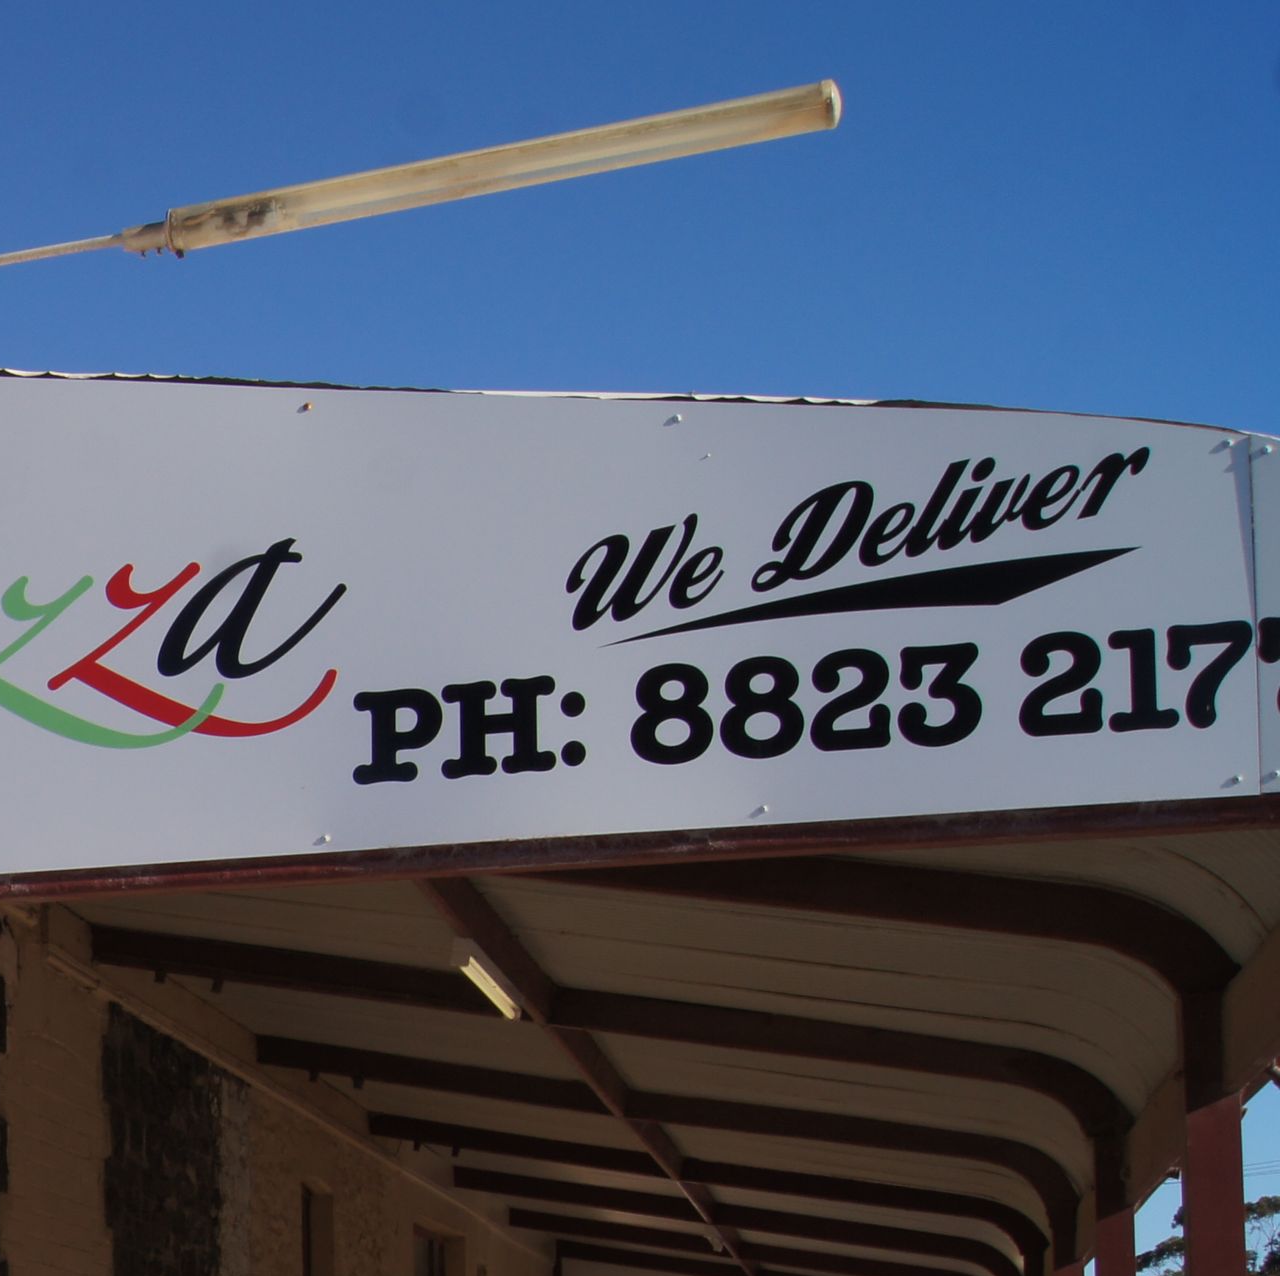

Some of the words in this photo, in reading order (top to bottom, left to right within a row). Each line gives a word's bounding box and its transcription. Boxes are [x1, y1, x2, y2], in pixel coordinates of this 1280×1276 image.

[565, 513, 724, 631] We
[751, 446, 1151, 593] Deliver
[352, 675, 587, 785] PH:
[630, 642, 983, 765] 8823
[1019, 617, 1280, 738] 217
